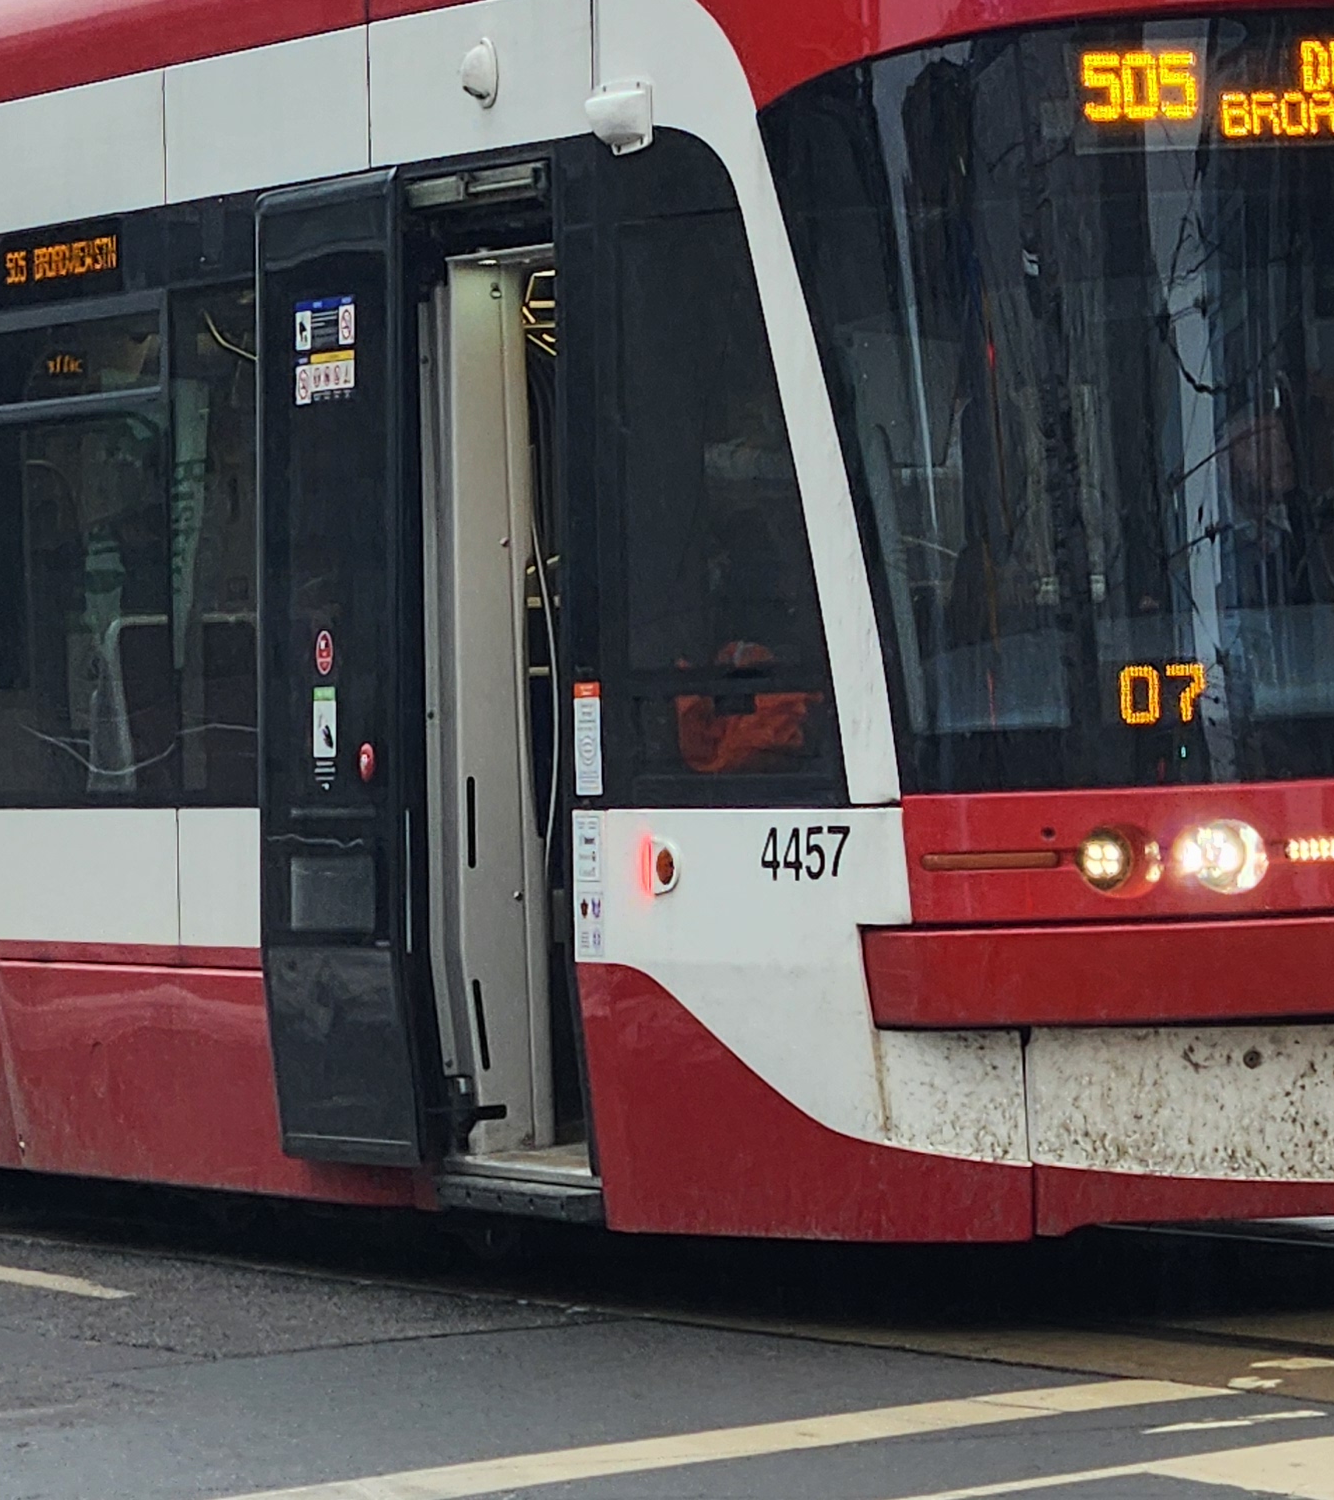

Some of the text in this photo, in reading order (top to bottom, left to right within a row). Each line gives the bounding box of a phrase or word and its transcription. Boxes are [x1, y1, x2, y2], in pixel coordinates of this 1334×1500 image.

[1081, 51, 1199, 121] 505
[1120, 661, 1205, 724] 07
[761, 825, 850, 881] 4457
